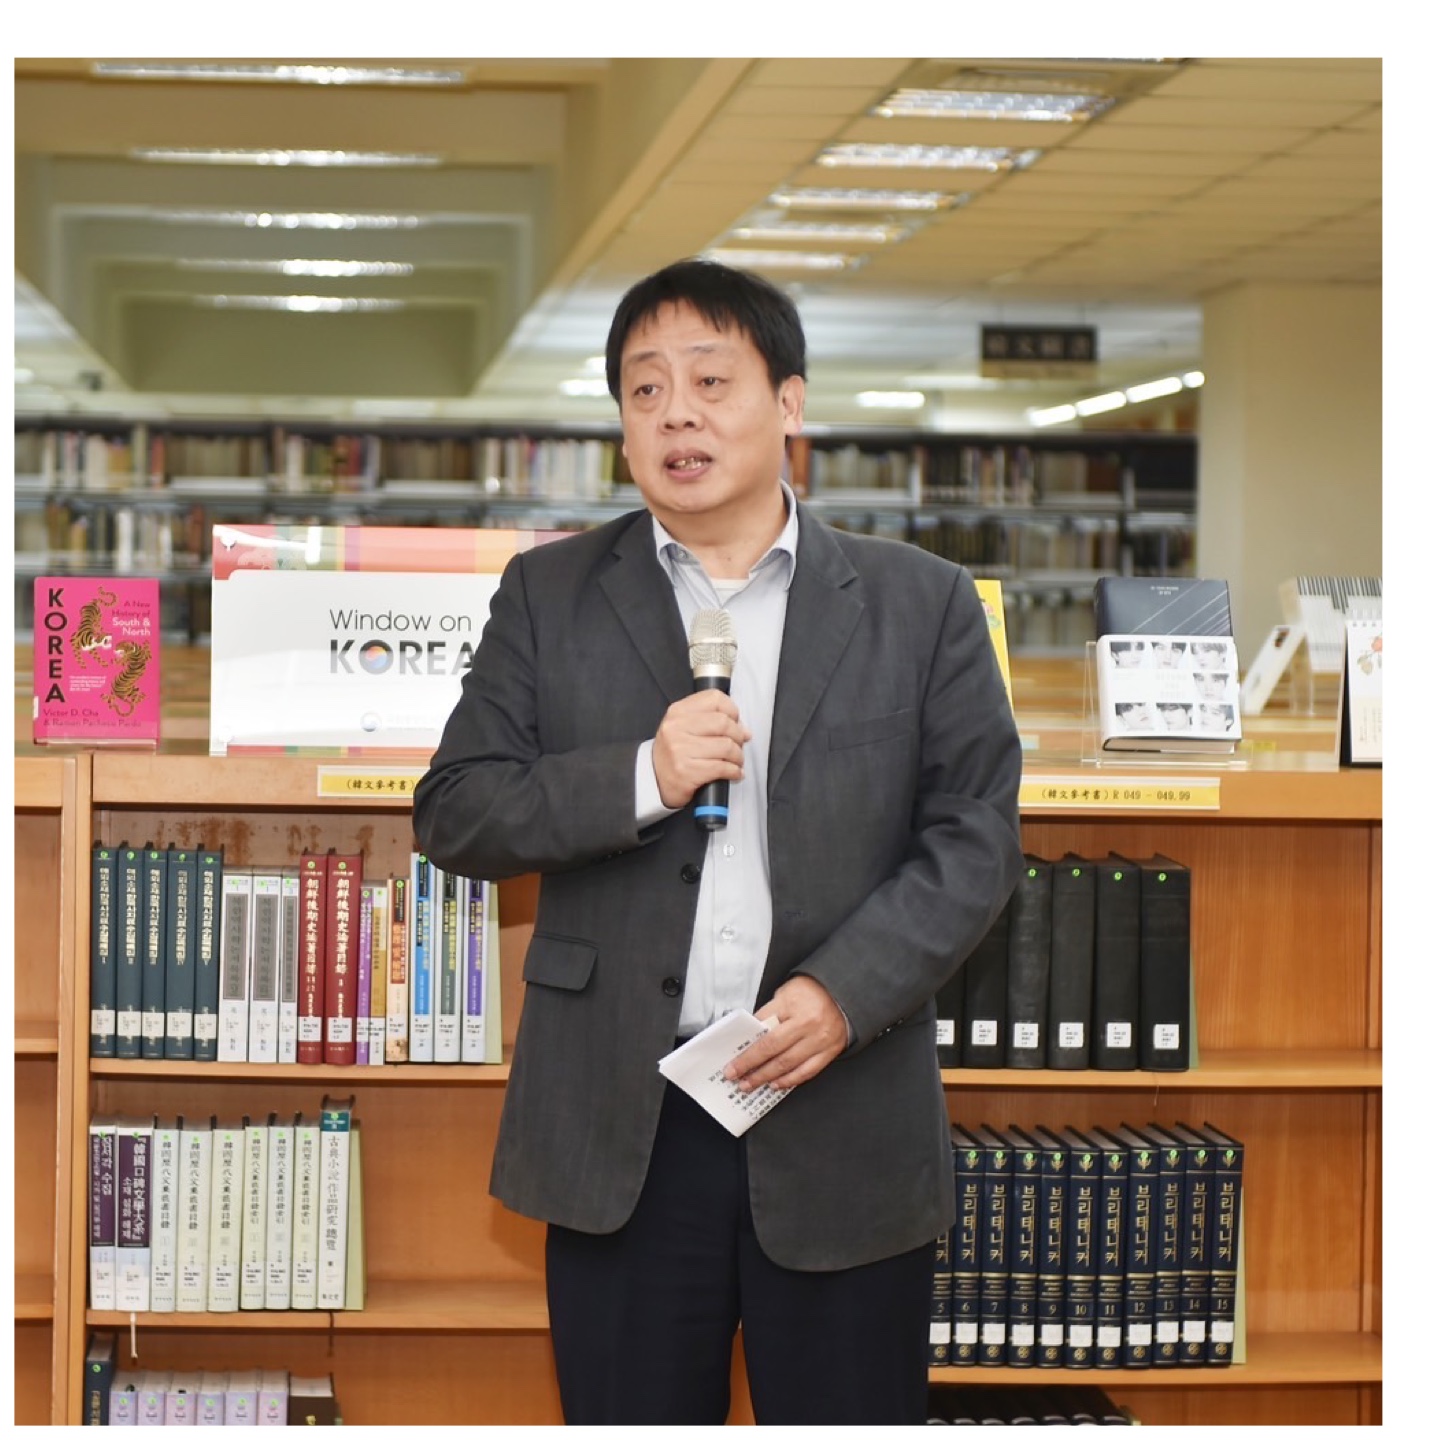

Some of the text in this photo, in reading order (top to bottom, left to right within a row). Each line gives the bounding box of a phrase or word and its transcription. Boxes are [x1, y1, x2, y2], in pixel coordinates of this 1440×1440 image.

[112, 617, 140, 626] South
[329, 608, 472, 632] Window on
[122, 627, 151, 636] North
[44, 588, 68, 703] KOREA
[329, 638, 476, 676] KOREA
[1123, 790, 1142, 801] 049
[1156, 790, 1191, 801] 049.99
[962, 1183, 979, 1264] 브리태니커
[989, 1183, 1007, 1265] 브리태니커
[1019, 1184, 1037, 1266] 브리태니커
[1047, 1186, 1064, 1266] 브리태니커
[1076, 1186, 1094, 1268] 브리태니커
[1105, 1186, 1123, 1267] 브리태니커
[1134, 1184, 1152, 1266] 브리태니커
[1163, 1182, 1180, 1262] 브리태니커
[1190, 1181, 1208, 1262] 브리태니커
[1217, 1181, 1235, 1262] 브리태니커
[962, 1302, 971, 1313] 6
[991, 1301, 998, 1313] 7
[1021, 1302, 1029, 1313] 8
[1049, 1304, 1057, 1315] 9
[1075, 1304, 1087, 1315] 10
[1104, 1304, 1115, 1315] 11
[1134, 1301, 1146, 1313] 12
[1163, 1300, 1175, 1311] 13
[1189, 1299, 1201, 1310] 14
[1217, 1299, 1228, 1310] 15
